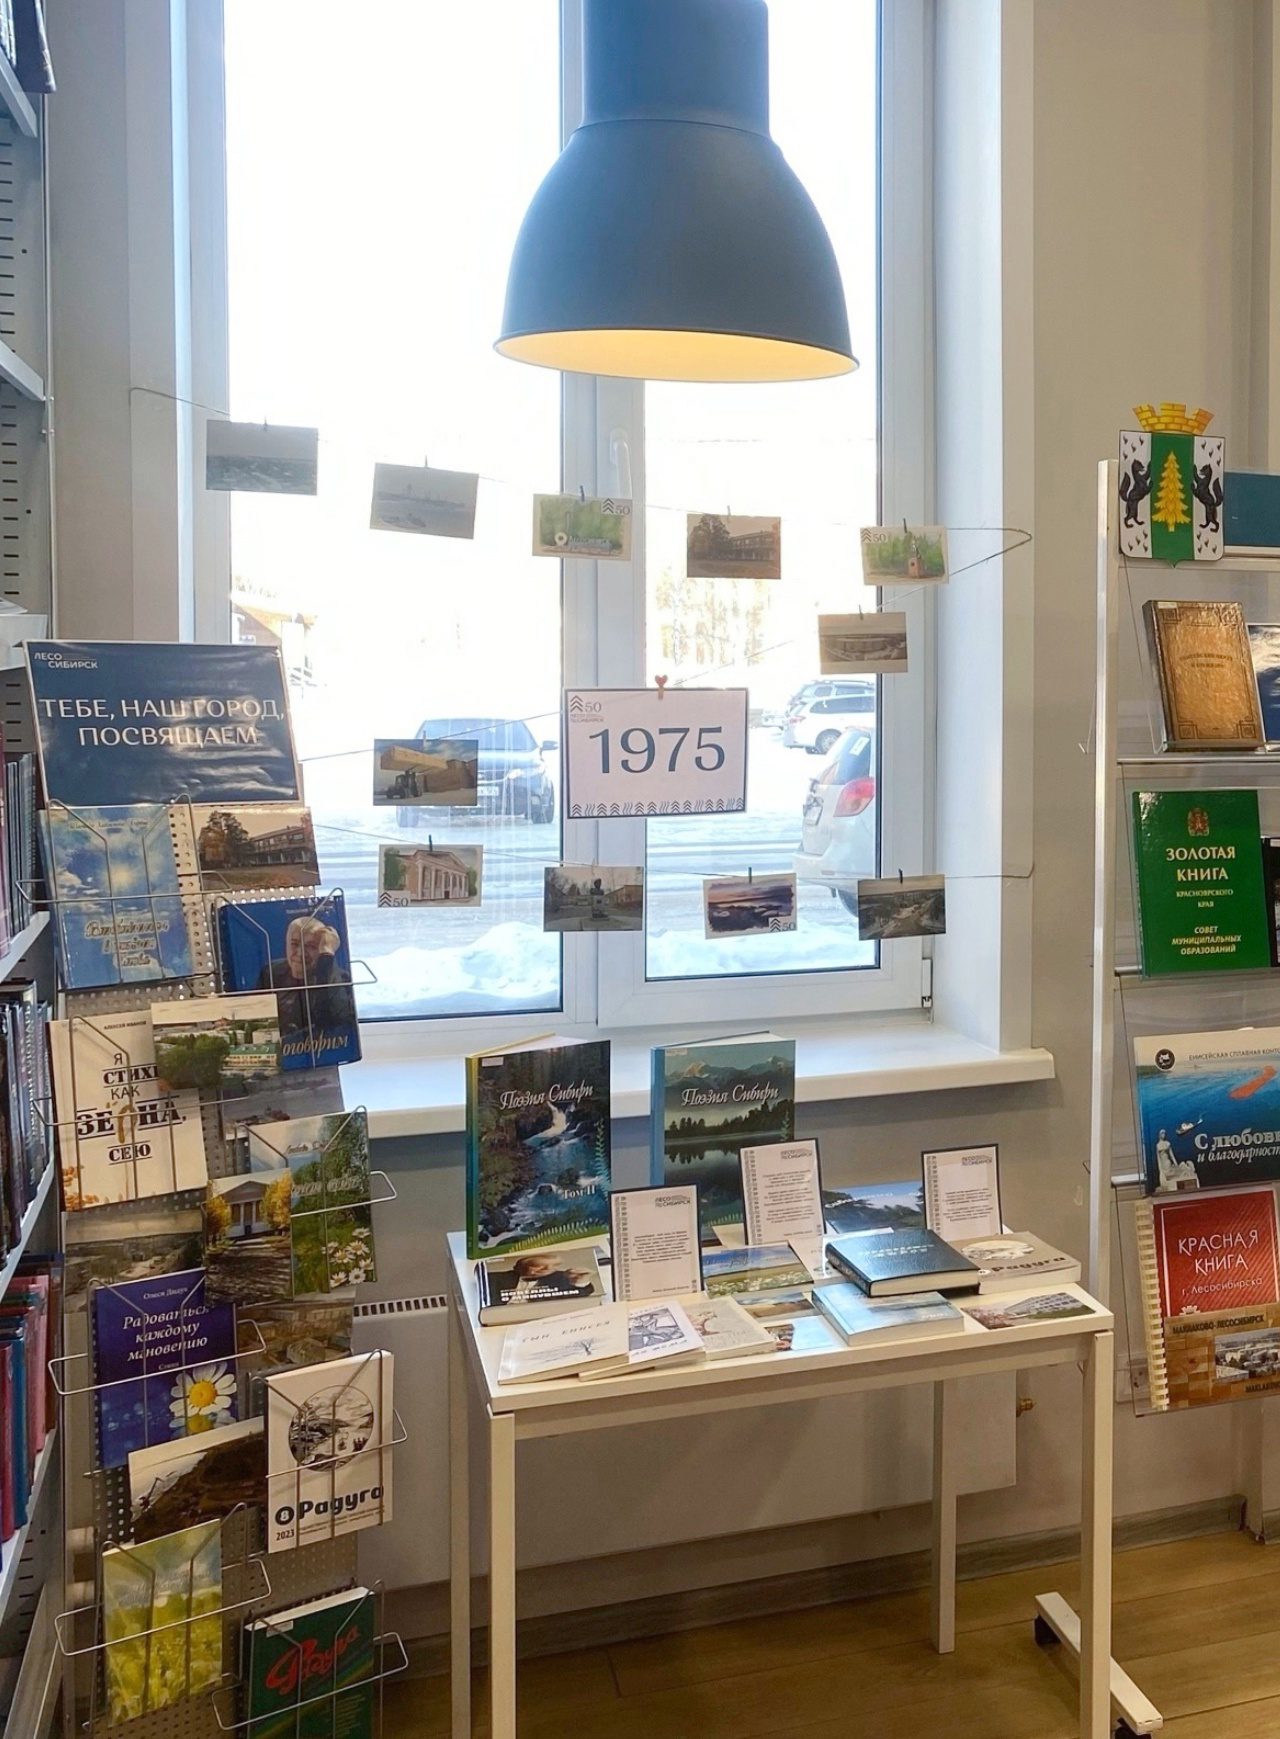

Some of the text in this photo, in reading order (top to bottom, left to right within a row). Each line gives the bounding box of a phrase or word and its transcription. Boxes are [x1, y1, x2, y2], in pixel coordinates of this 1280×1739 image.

[34, 651, 62, 661] ЛЕСО
[48, 660, 99, 669] СИБИРСК
[40, 699, 285, 721] ТЕБЕ, НАШ ГОРОД,
[585, 701, 602, 713] 50
[79, 727, 257, 748] ПОСВЯЩАЕМ
[588, 725, 726, 775] 1975
[1166, 846, 1236, 861] ЗОЛОТАЯ
[1177, 867, 1229, 882] КНИГА
[1176, 889, 1234, 898] КРАСНОЯРСКОГО
[1194, 926, 1218, 934] СОВЕТ
[1171, 935, 1241, 946] МУНИЦИПАЛЬНЫХ
[1180, 945, 1236, 956] ОБРАЗОВАНИЙ
[281, 1031, 348, 1058] оговорим
[114, 1053, 123, 1065] Я
[1188, 1052, 1229, 1060] ЕНИСЕЙСКАЯ
[1230, 1050, 1261, 1058] СПЛАВНАЯ
[111, 1086, 140, 1100] КАК
[500, 1081, 594, 1110] Поэзия Сибири
[681, 1081, 779, 1107] Поэзия Сибири
[1195, 1133, 1208, 1150] С
[109, 1144, 151, 1161] СЕЮ
[1197, 1152, 1205, 1163] и
[1179, 1230, 1259, 1256] КРАСНАЯ
[1195, 1253, 1248, 1276] КНИГА
[1182, 1276, 1263, 1296] г. Лесосибирска
[135, 1322, 200, 1343] каждому
[298, 1485, 384, 1520] Радуга
[276, 1528, 295, 1541] 2023
